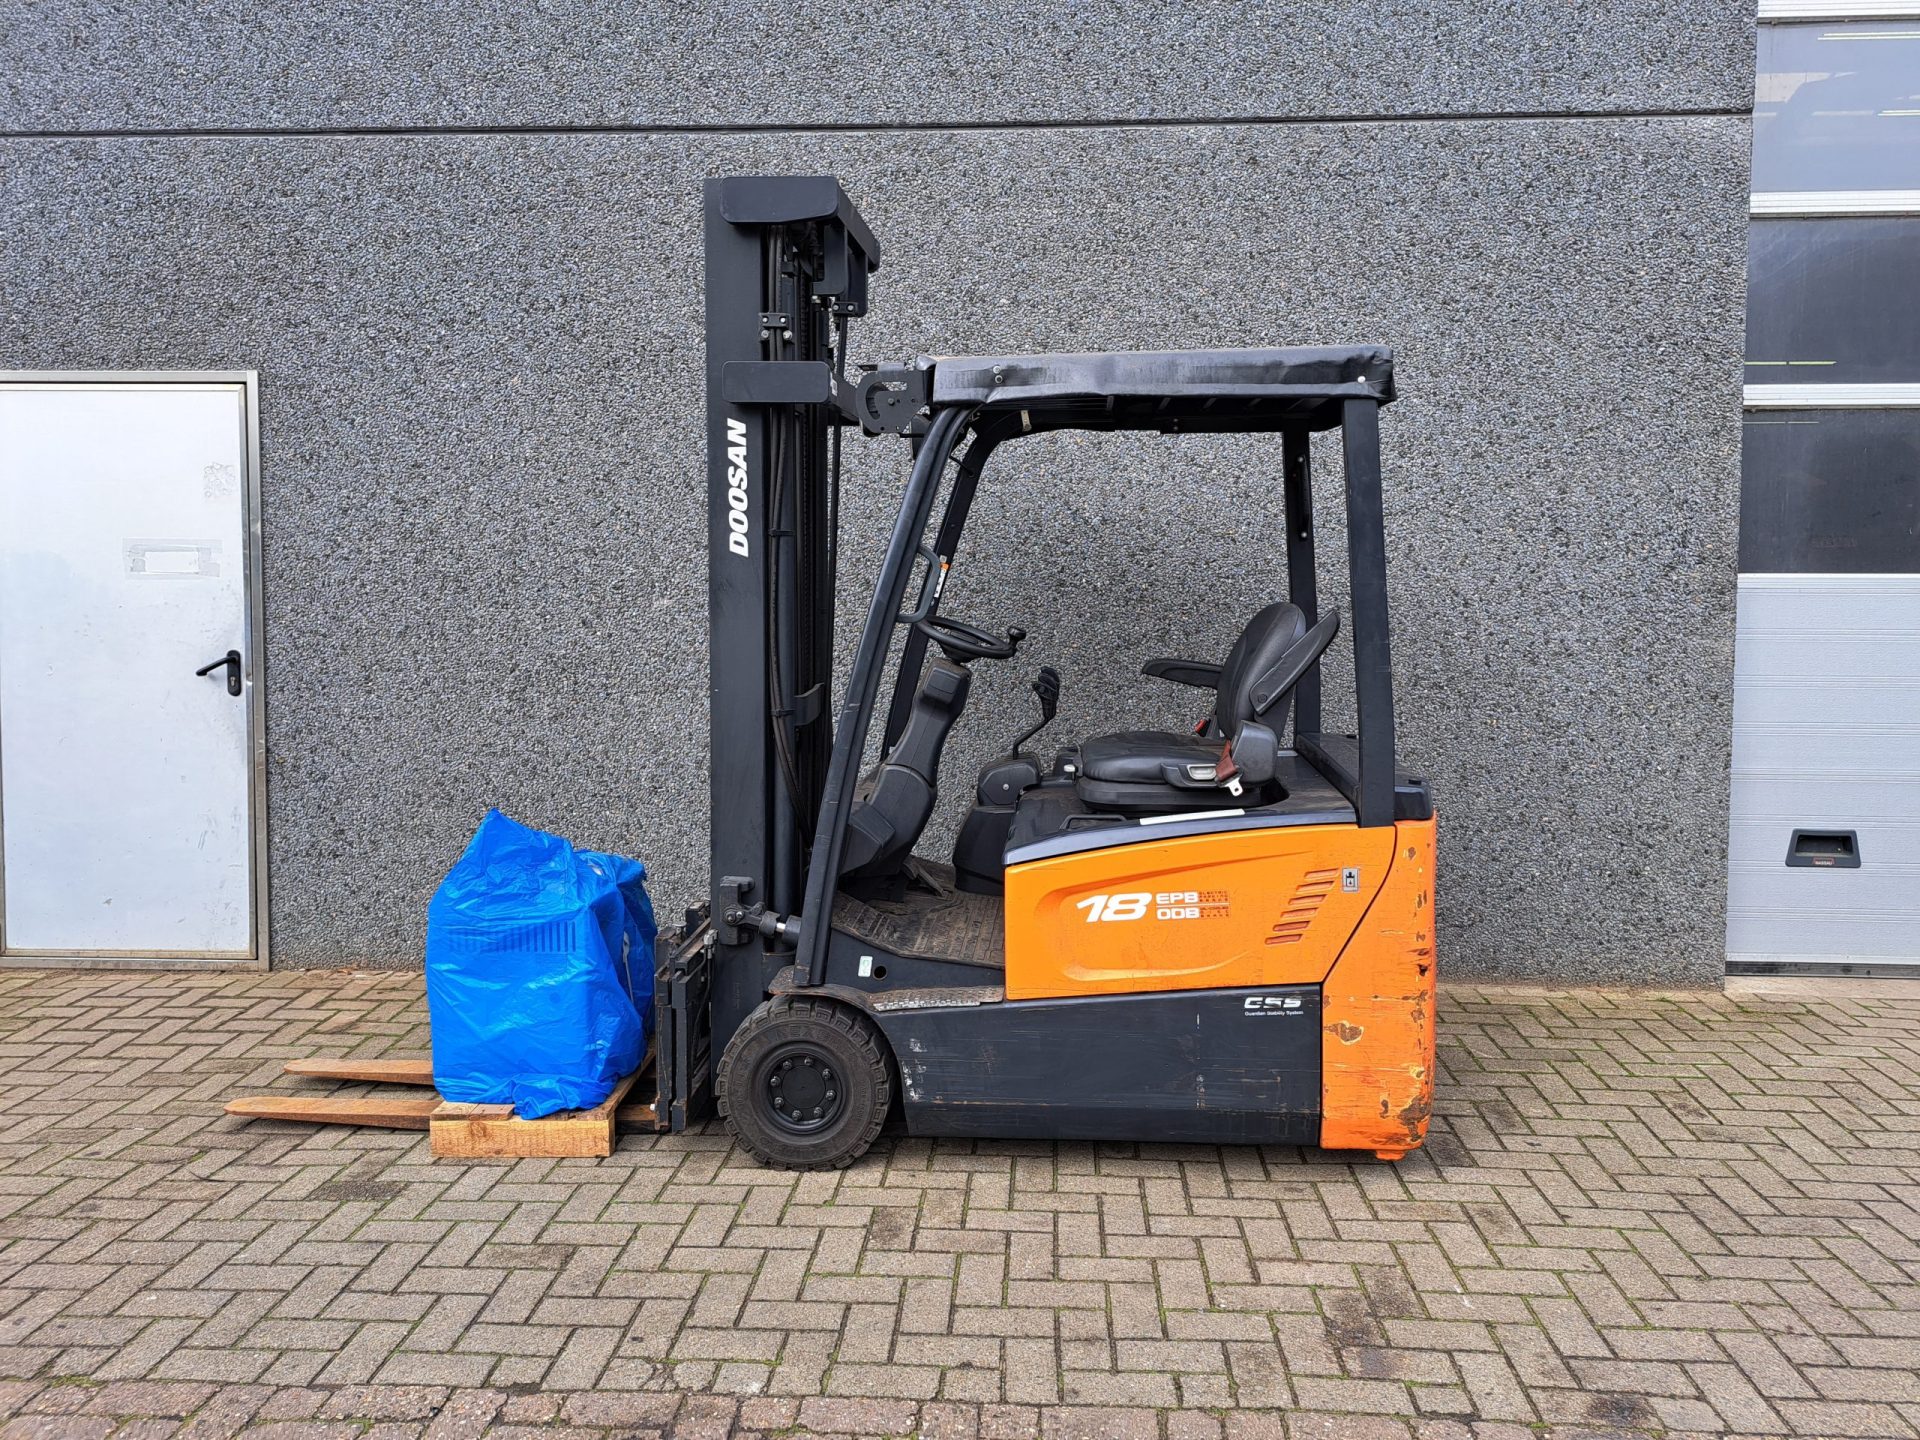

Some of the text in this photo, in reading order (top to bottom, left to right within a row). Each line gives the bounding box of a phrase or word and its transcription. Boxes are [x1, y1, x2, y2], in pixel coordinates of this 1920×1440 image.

[727, 417, 749, 558] DOOSAN
[1076, 892, 1153, 923] 18
[1156, 891, 1199, 904] EPB
[1157, 907, 1200, 920] ODB
